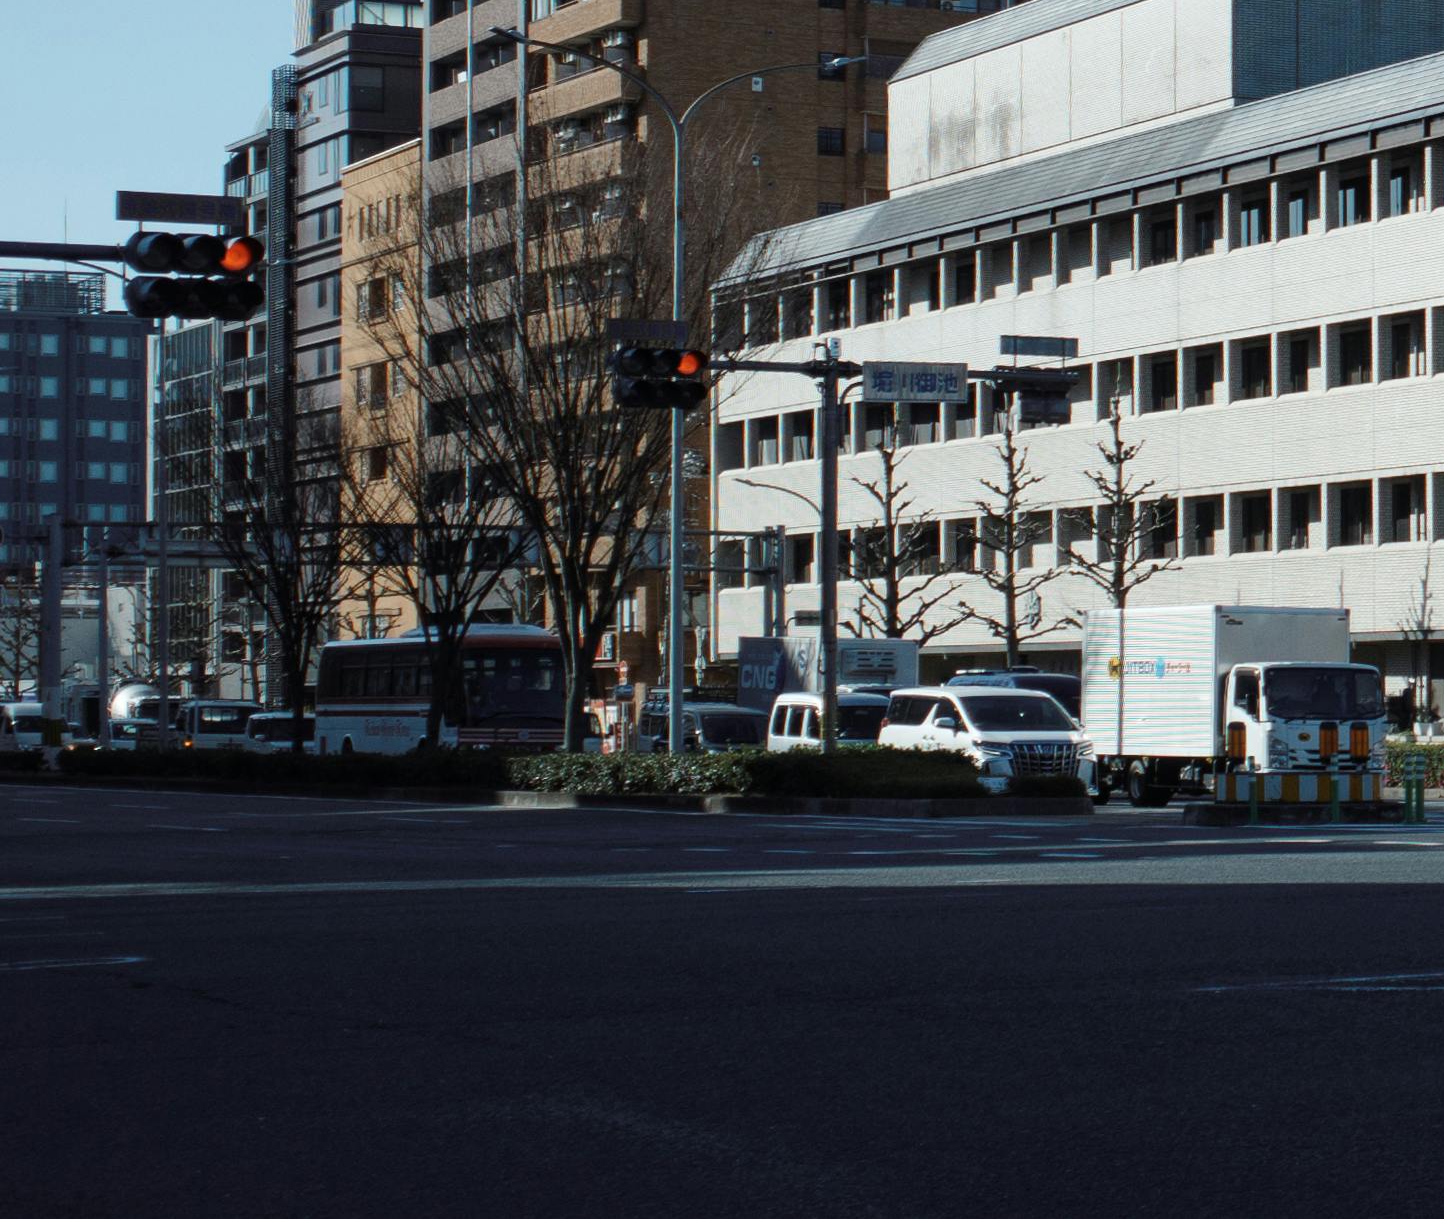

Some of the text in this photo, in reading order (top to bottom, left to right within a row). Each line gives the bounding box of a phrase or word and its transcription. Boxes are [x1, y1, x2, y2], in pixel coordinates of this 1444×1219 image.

[872, 371, 958, 394] 堀川御池
[741, 664, 776, 690] CNG
